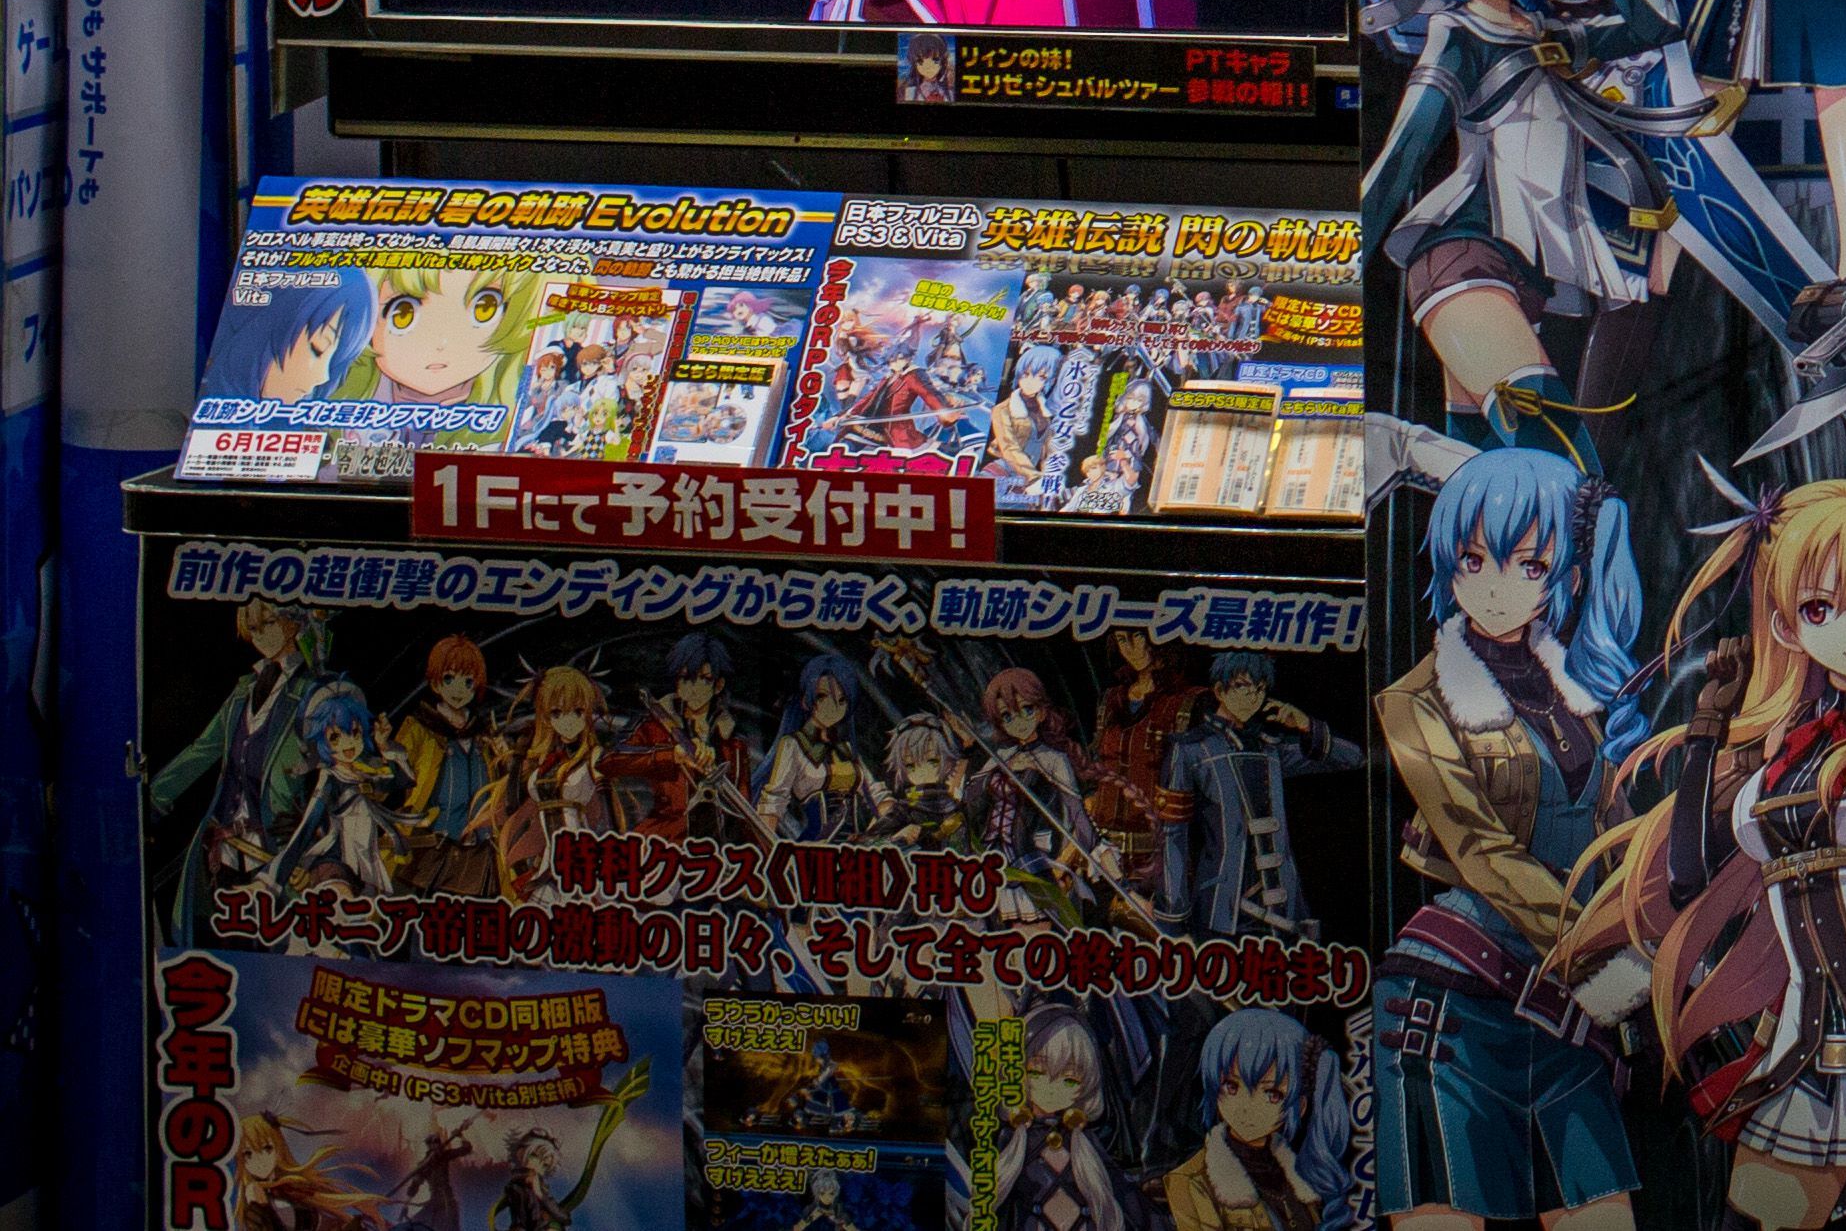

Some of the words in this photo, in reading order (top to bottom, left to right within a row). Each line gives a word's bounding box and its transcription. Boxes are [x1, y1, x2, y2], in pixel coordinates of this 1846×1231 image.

[960, 46, 1073, 71] リィンの妹!
[959, 74, 1180, 102] エリゼ・シュバルツァー
[78, 47, 107, 206] サポートも
[289, 184, 440, 226] 英雄伝説
[586, 193, 798, 236] Evolution
[841, 200, 981, 228] 日本ファルコム
[838, 224, 883, 247] PS3
[912, 226, 967, 251] Vita
[978, 207, 1166, 256] 英雄伝説
[236, 270, 342, 288] 日本ファルコム
[233, 288, 272, 306] Vita
[215, 431, 302, 454] 6月12日
[432, 463, 968, 550] 1Fにて予約受付中!
[311, 969, 606, 1028] 限定ドラマCD同梱版
[1000, 1017, 1026, 1108] 新キャラ
